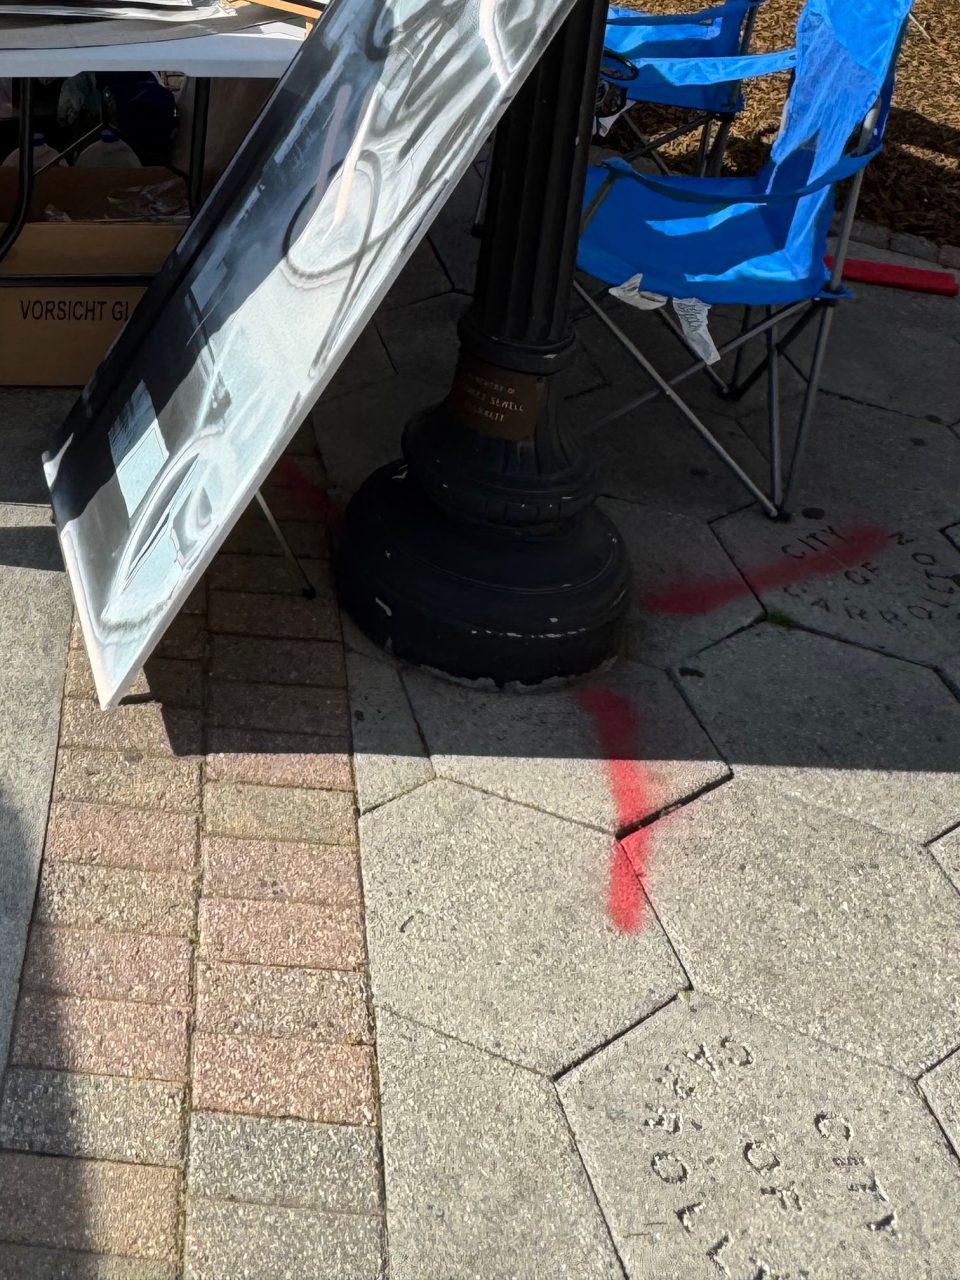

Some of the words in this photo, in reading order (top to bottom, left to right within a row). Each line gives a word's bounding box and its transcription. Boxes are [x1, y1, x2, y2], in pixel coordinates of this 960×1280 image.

[20, 300, 107, 321] VORSICHT
[781, 525, 849, 560] CITY
[844, 562, 879, 585] OF
